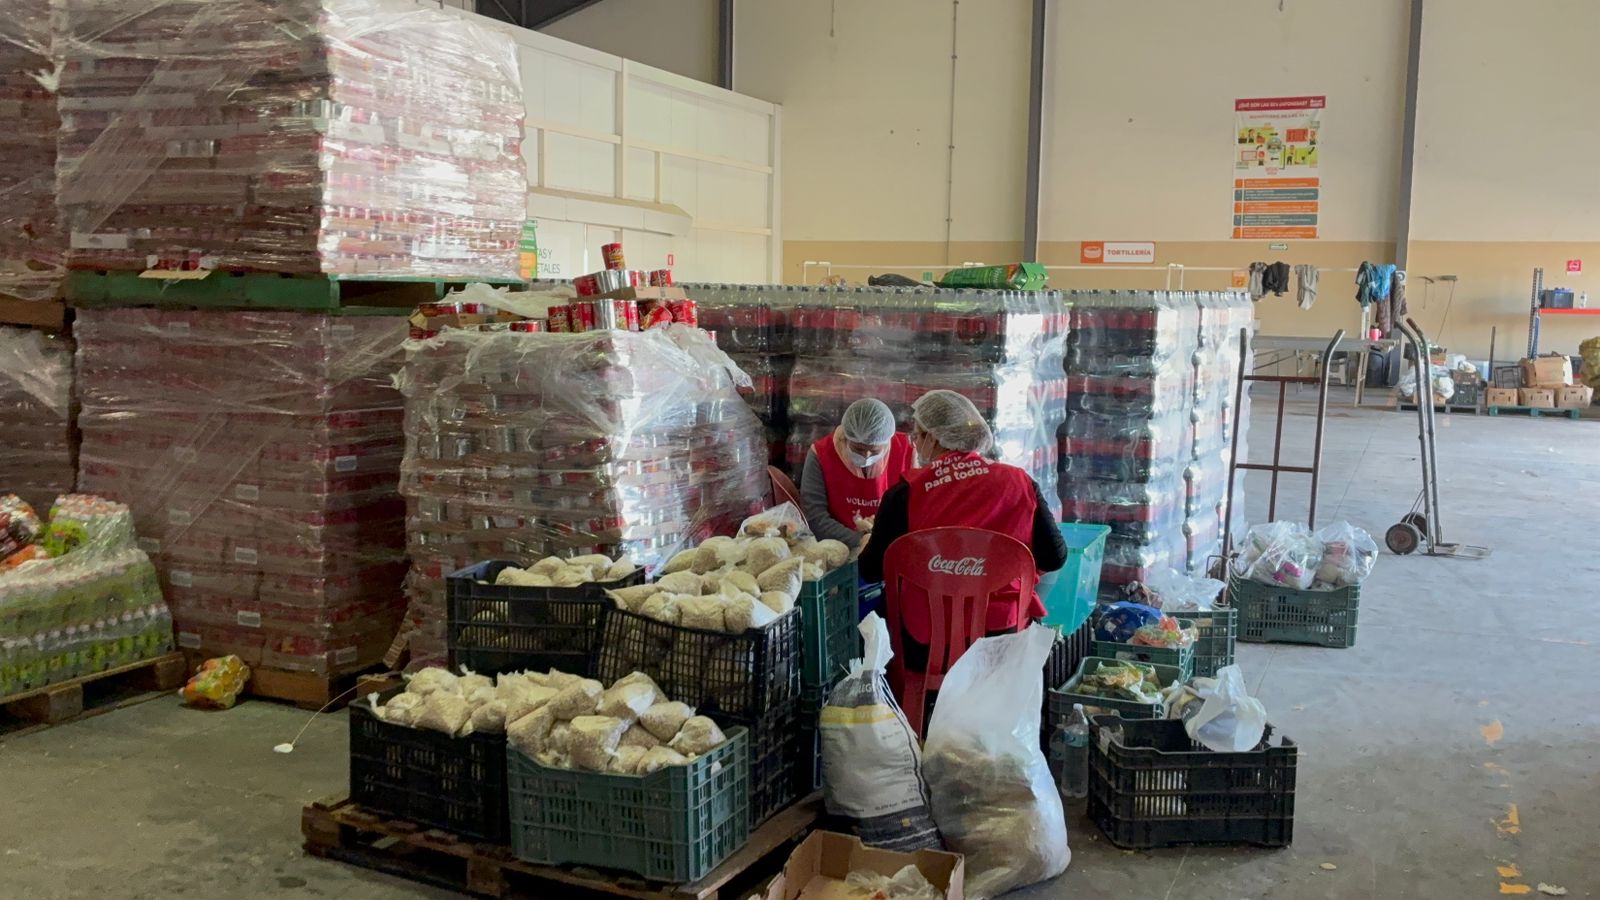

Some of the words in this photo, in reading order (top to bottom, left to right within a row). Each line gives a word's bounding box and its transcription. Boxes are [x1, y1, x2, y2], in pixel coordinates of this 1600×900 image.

[924, 475, 952, 492] para
[953, 467, 990, 480] todos
[935, 466, 950, 477] de
[928, 554, 986, 575] Coca-Cola
